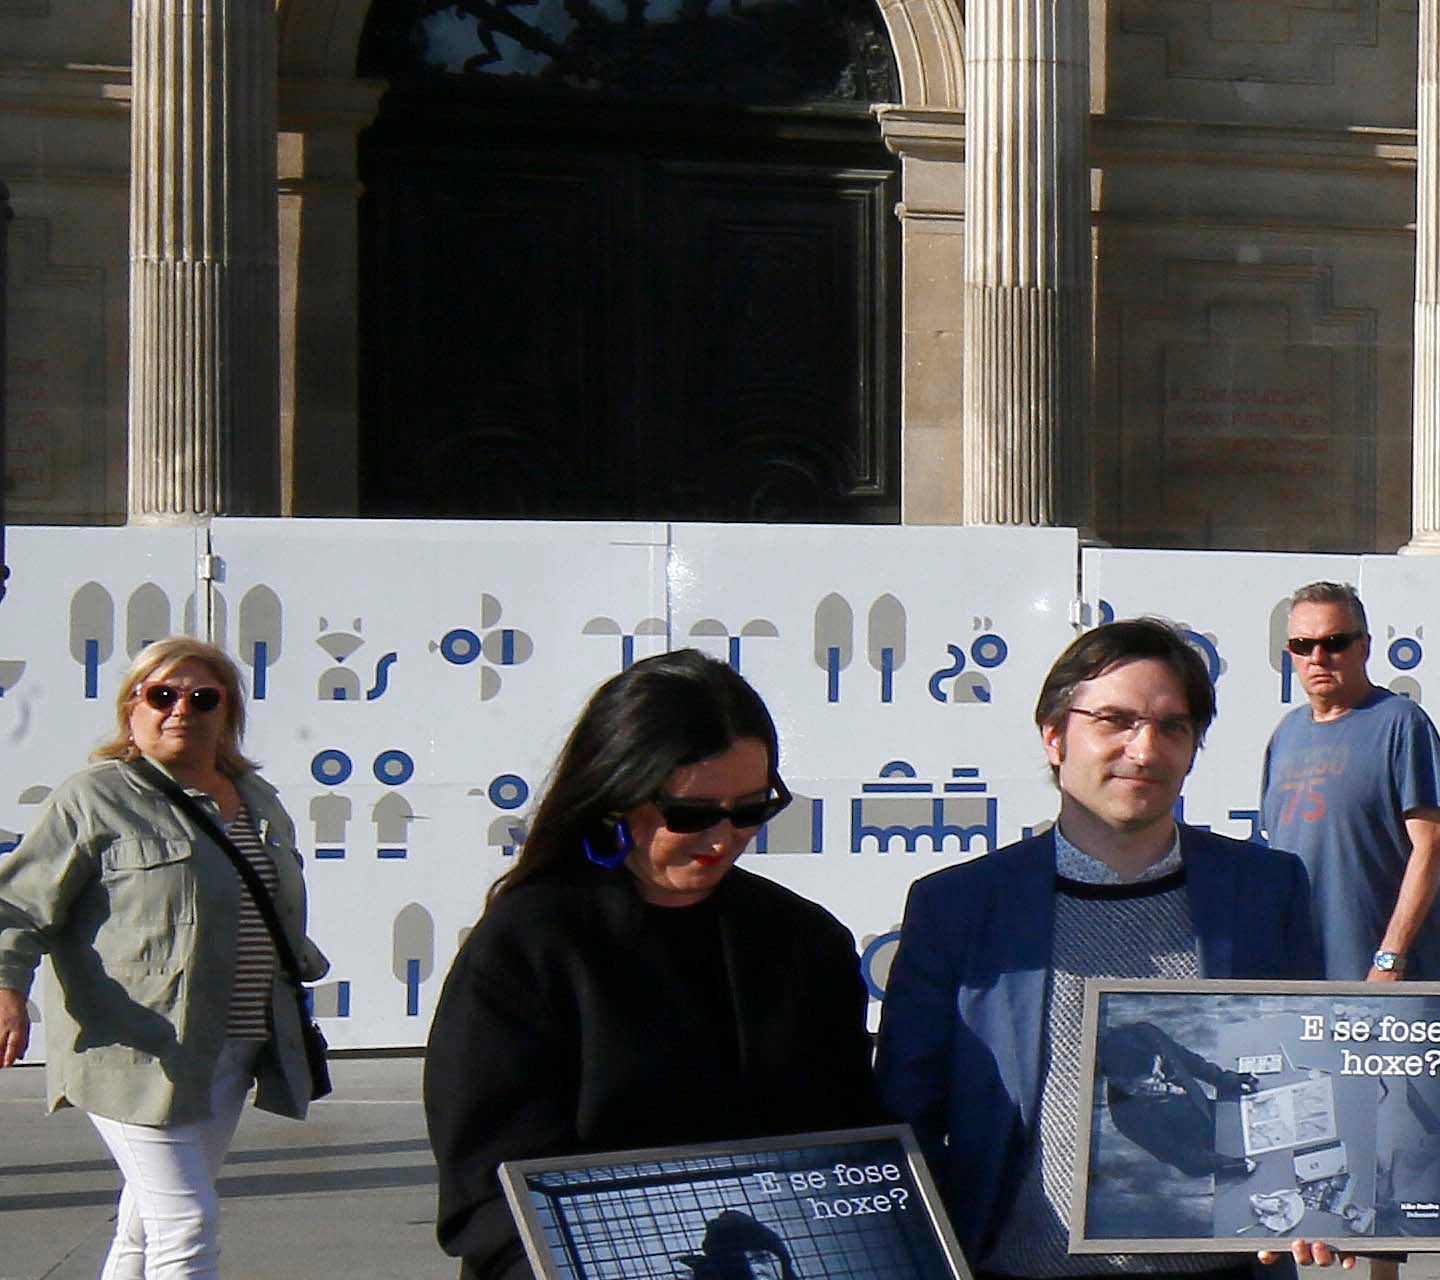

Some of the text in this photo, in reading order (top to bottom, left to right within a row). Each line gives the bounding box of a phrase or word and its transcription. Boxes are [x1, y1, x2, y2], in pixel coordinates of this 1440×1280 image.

[1299, 1016, 1324, 1041] E
[1333, 1022, 1371, 1042] se
[753, 1161, 901, 1195] E se fose
[807, 1187, 909, 1220] hoxe?
